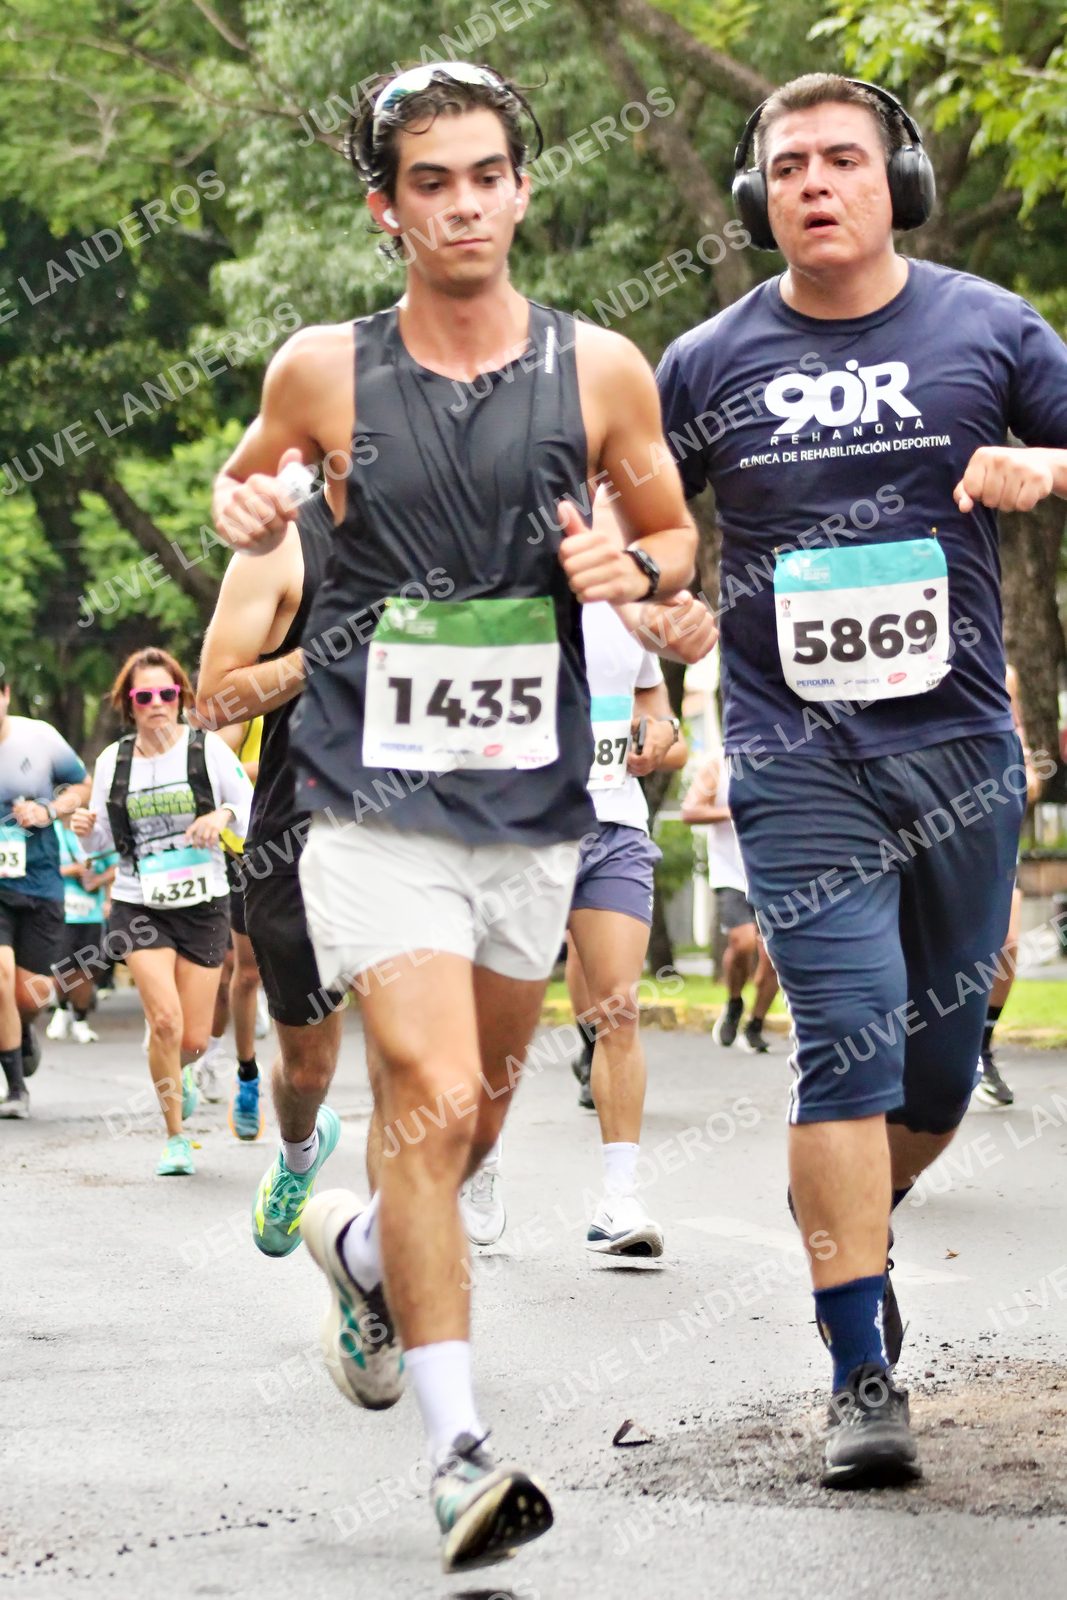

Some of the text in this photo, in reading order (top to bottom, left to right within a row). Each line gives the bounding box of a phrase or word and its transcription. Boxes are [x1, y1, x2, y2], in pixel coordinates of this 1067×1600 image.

[770, 418, 924, 446] REHANOVA
[782, 451, 798, 463] DE
[800, 440, 891, 461] REHABILITACIÓN
[893, 434, 952, 451] DEPORTIVA
[792, 609, 938, 665] 5869
[387, 676, 543, 728] 1435
[592, 738, 628, 766] 87
[151, 877, 207, 903] 4321
